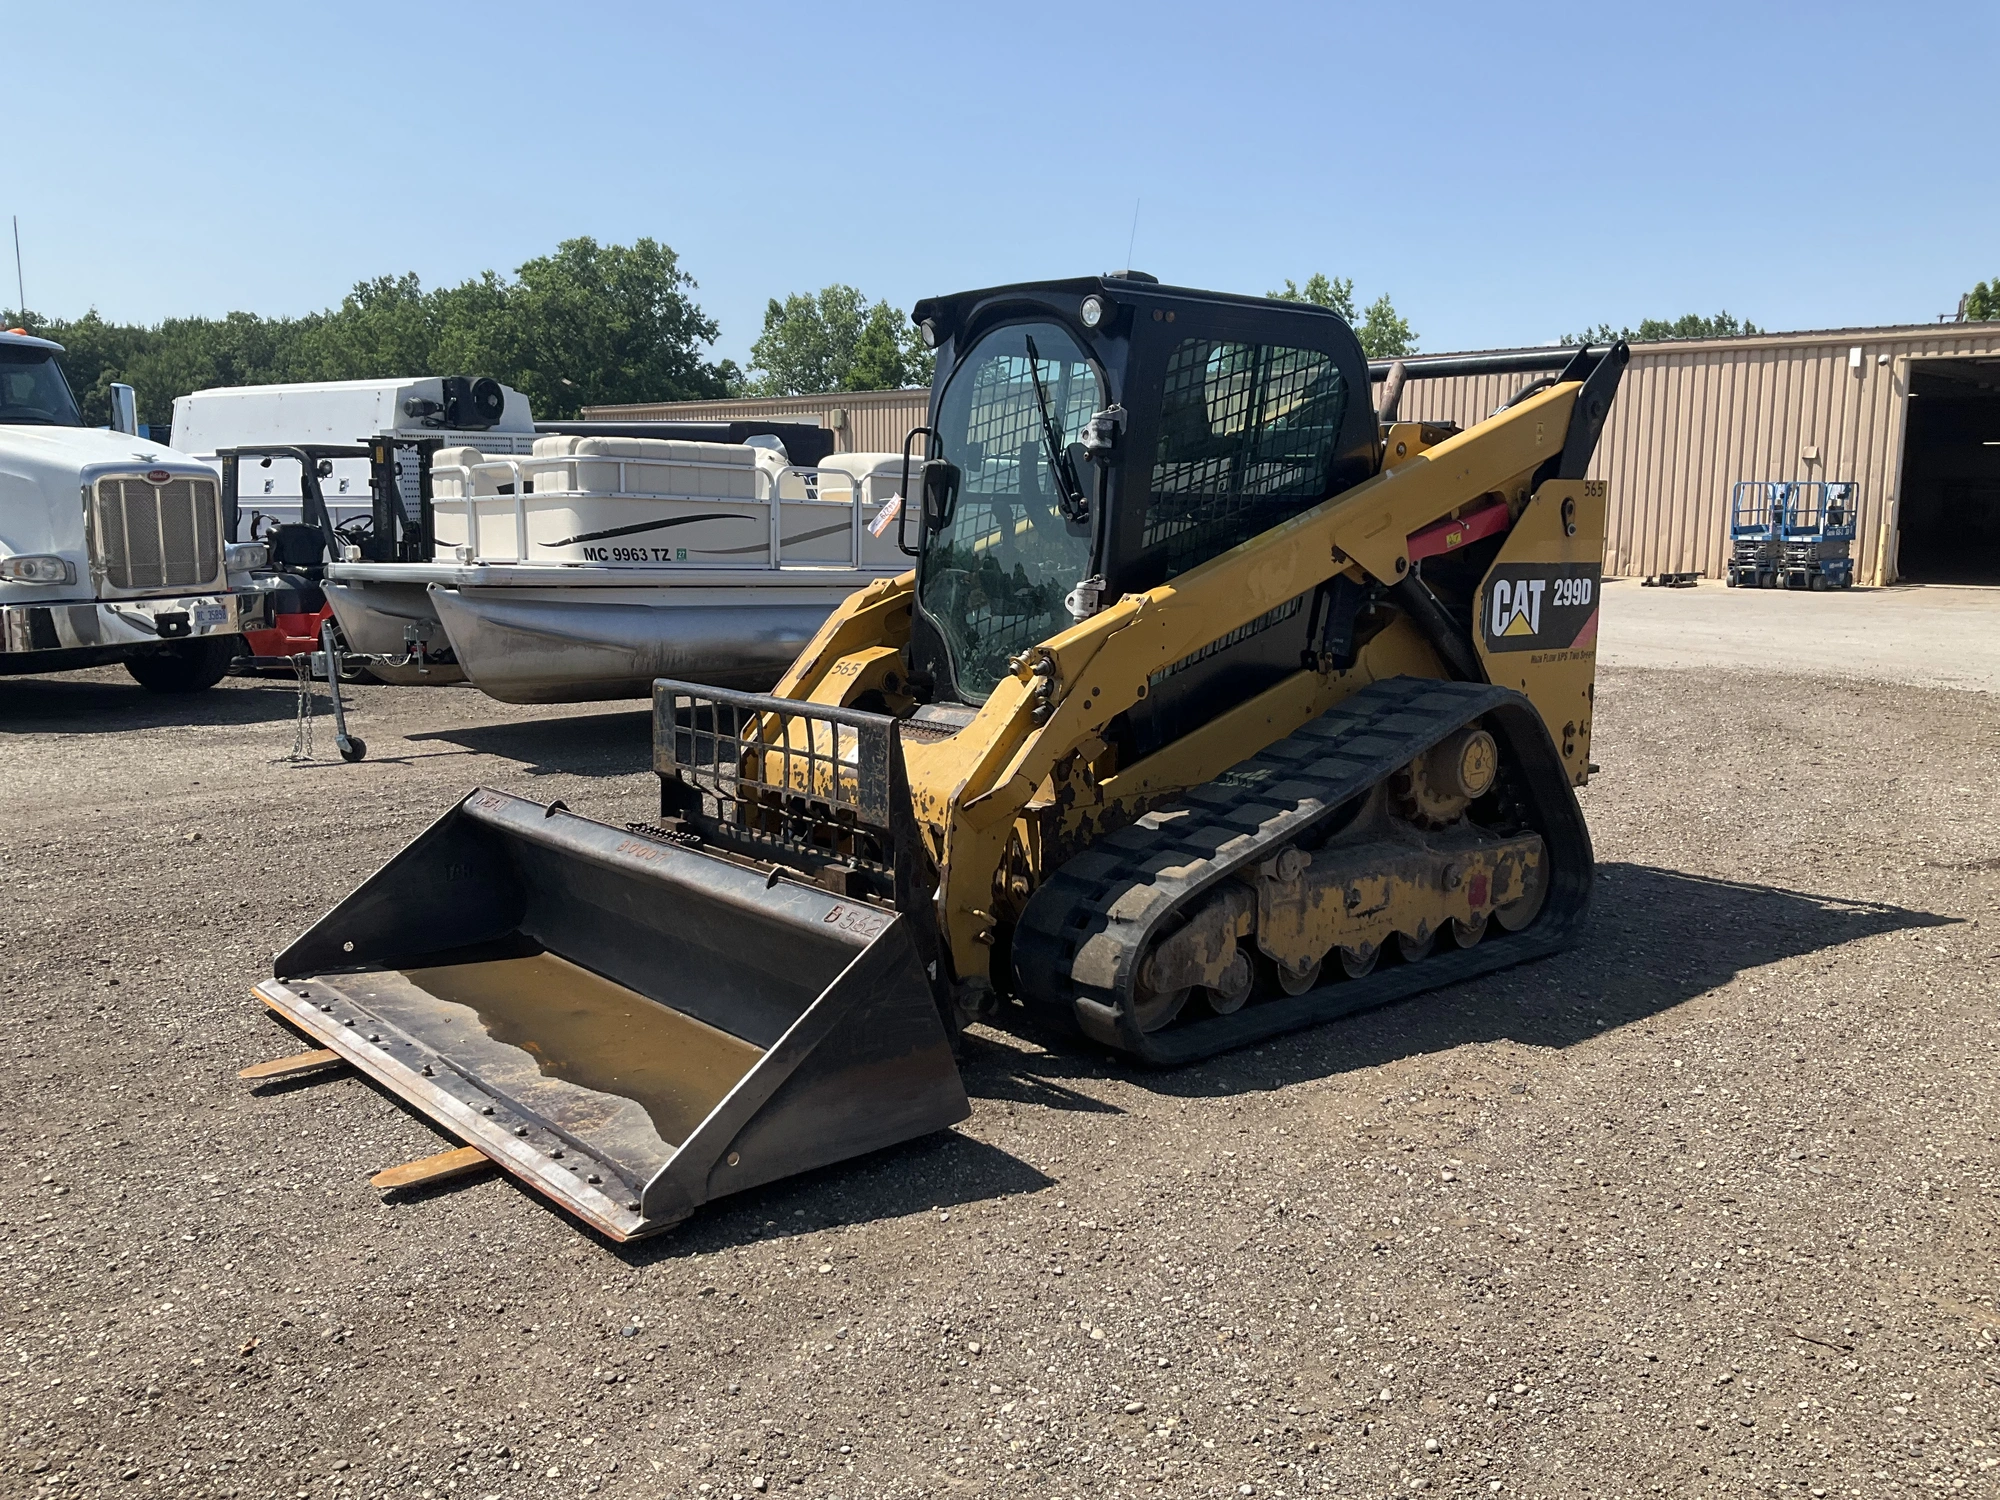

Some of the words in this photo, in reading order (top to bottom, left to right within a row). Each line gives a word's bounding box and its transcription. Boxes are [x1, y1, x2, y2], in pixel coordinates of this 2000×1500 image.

[1584, 481, 1603, 497] 565
[583, 547, 609, 561] MC
[612, 547, 648, 562] 9963
[651, 548, 671, 562] TZ
[677, 550, 685, 558] 27
[1491, 579, 1546, 637] CAT
[1552, 578, 1592, 606] 299D
[831, 661, 862, 677] 565
